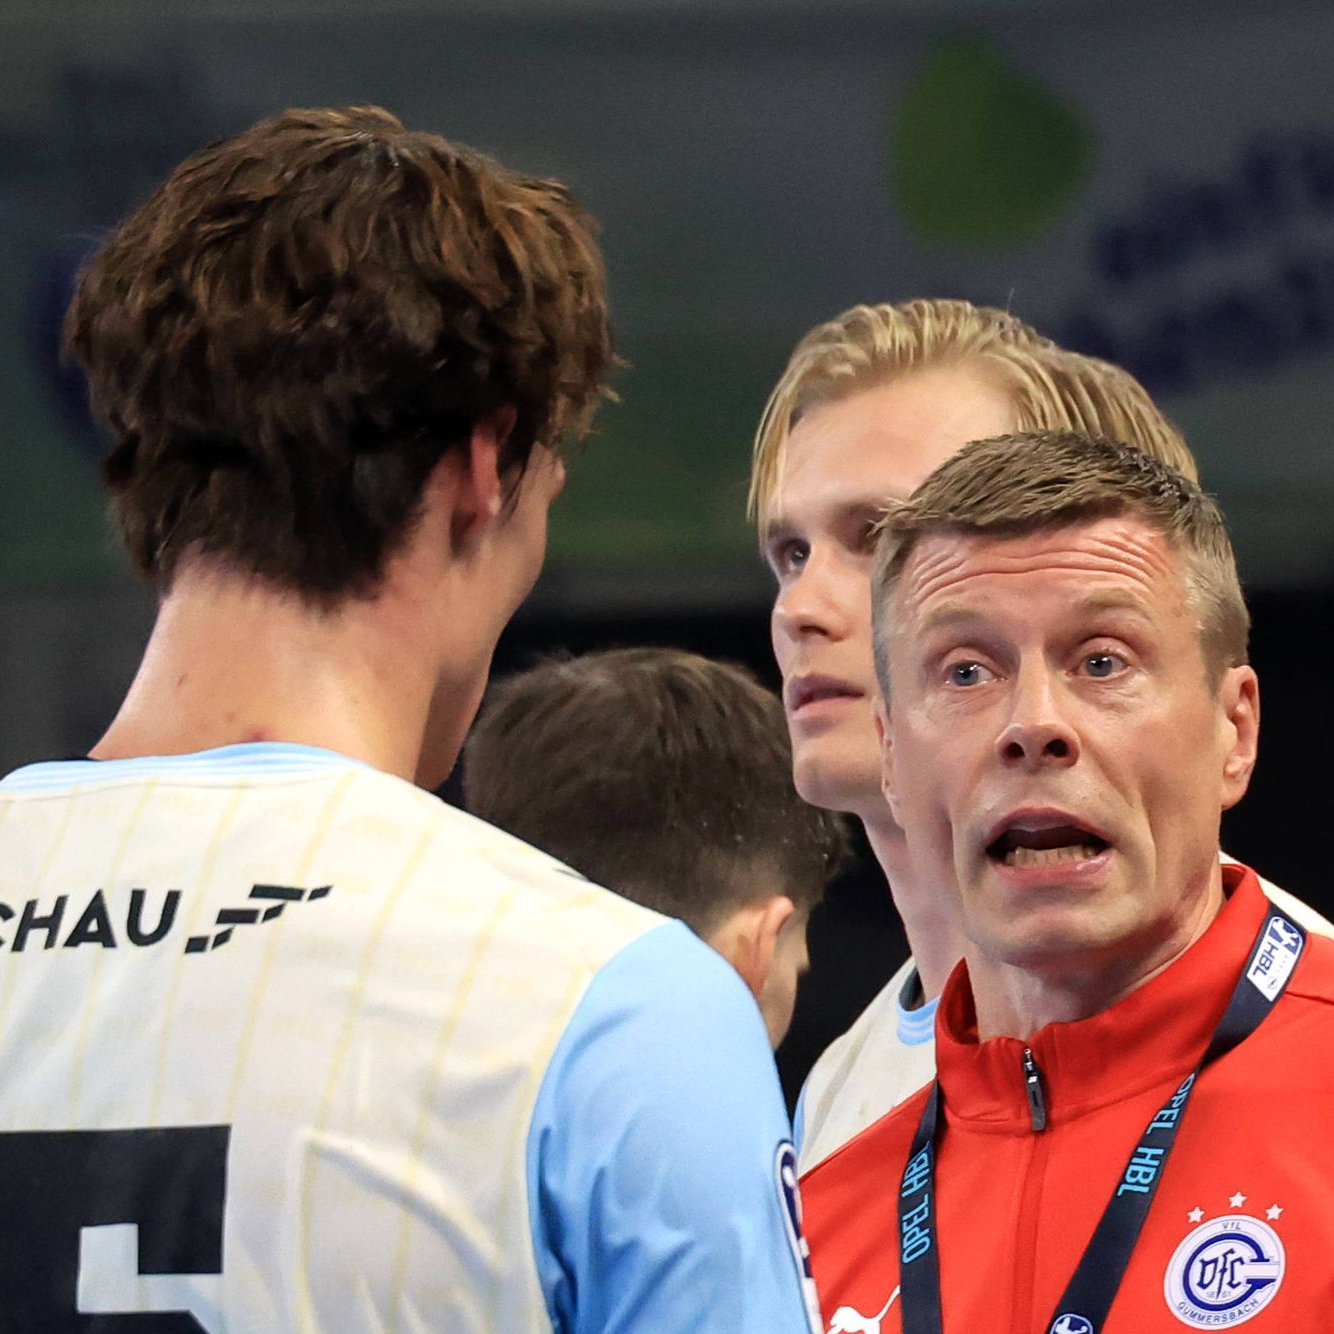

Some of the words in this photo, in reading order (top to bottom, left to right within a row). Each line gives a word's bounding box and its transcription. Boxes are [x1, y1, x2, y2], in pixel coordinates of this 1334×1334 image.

[1252, 941, 1279, 976] HBL
[1117, 1146, 1165, 1197] HBL
[901, 1193, 931, 1264] OPEL
